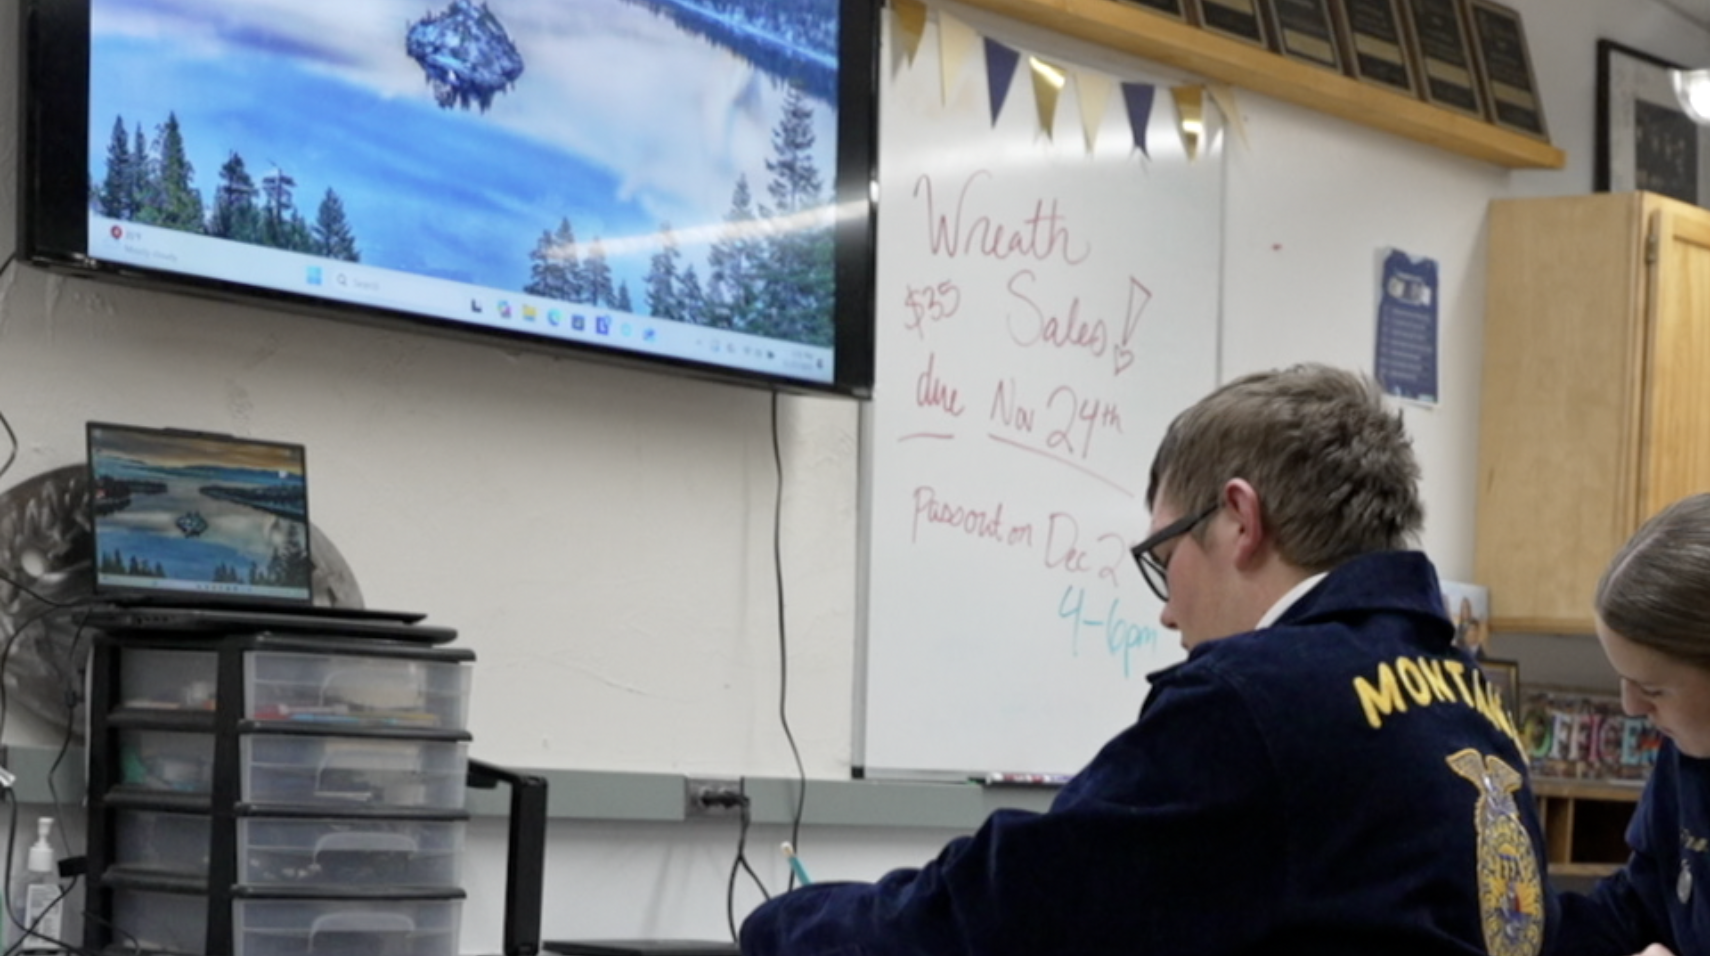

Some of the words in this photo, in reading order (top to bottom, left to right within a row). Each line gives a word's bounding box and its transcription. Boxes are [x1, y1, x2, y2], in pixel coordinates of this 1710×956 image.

[913, 168, 1092, 266] Wreath
[916, 352, 965, 417] due
[1046, 384, 1123, 460] 24th
[1044, 511, 1091, 573] Dec
[1096, 532, 1136, 588] 2
